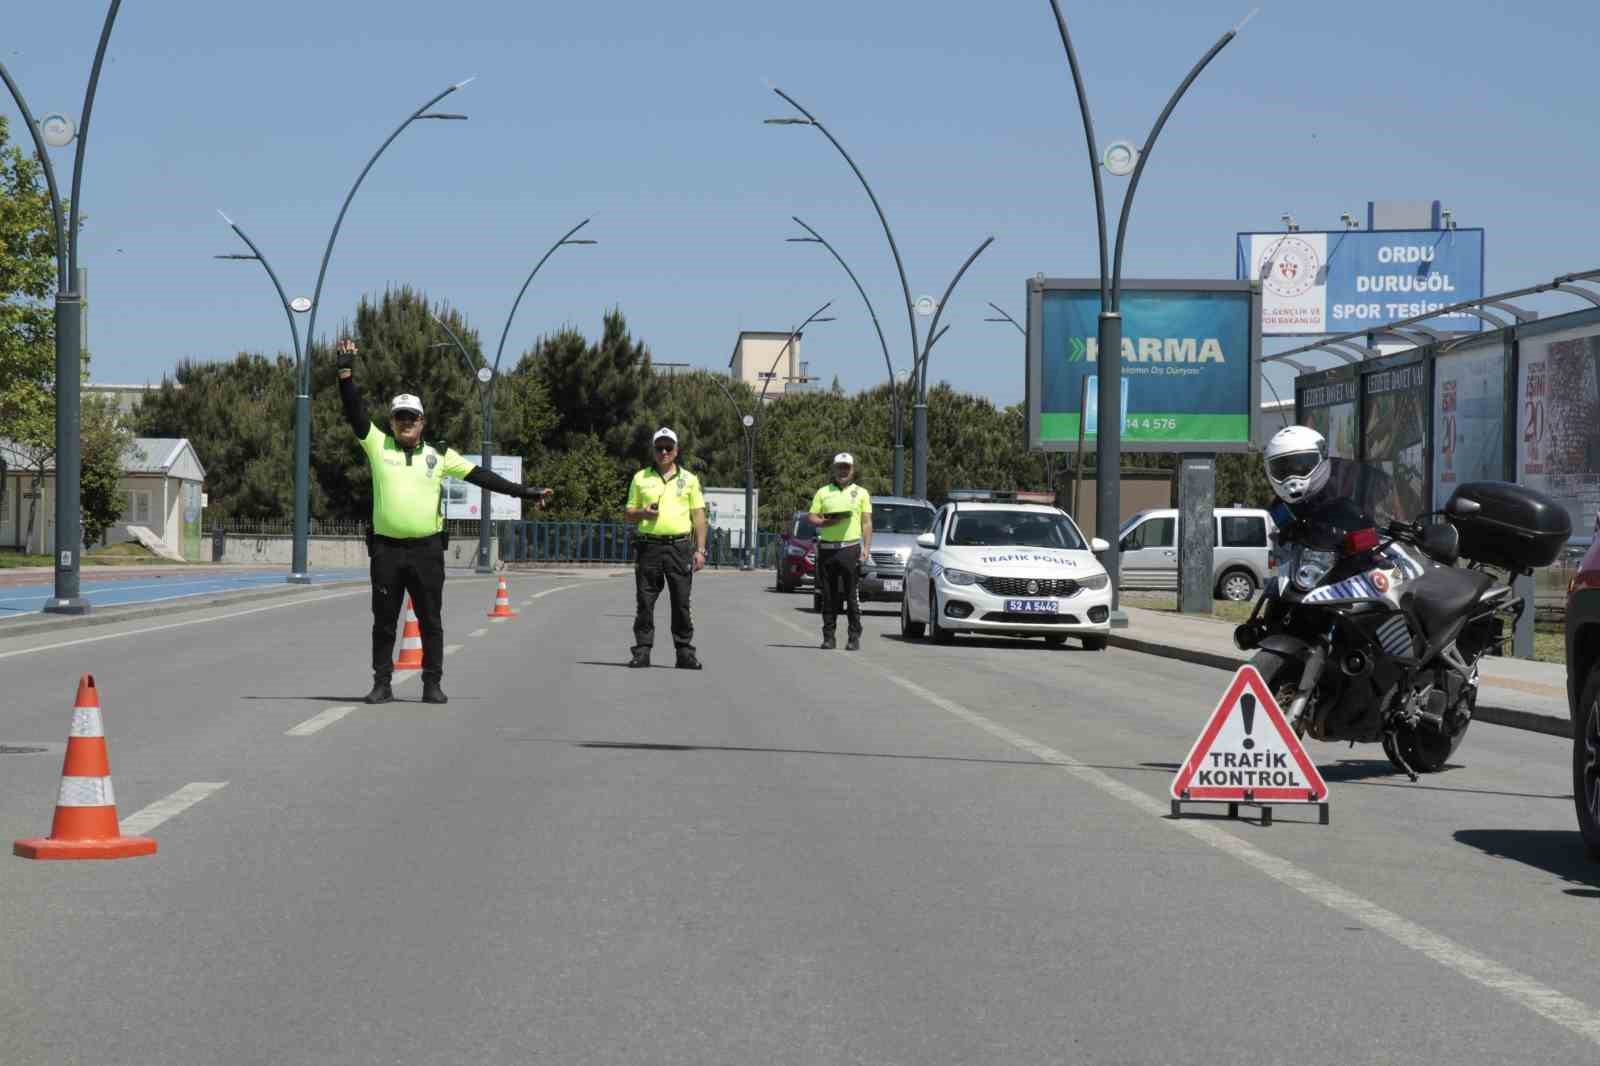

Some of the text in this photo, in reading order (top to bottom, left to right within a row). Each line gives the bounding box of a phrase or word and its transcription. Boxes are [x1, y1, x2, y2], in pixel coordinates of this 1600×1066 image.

[1378, 246, 1435, 263] ORDU
[1356, 271, 1455, 292] DURUGÖL
[1332, 303, 1380, 319] SPOR
[1152, 418, 1177, 430] 576
[1524, 401, 1544, 441] 20
[1010, 600, 1058, 612] 52 A 5442
[1209, 748, 1288, 769] TRAFİK
[1199, 771, 1300, 787] KONTROL
